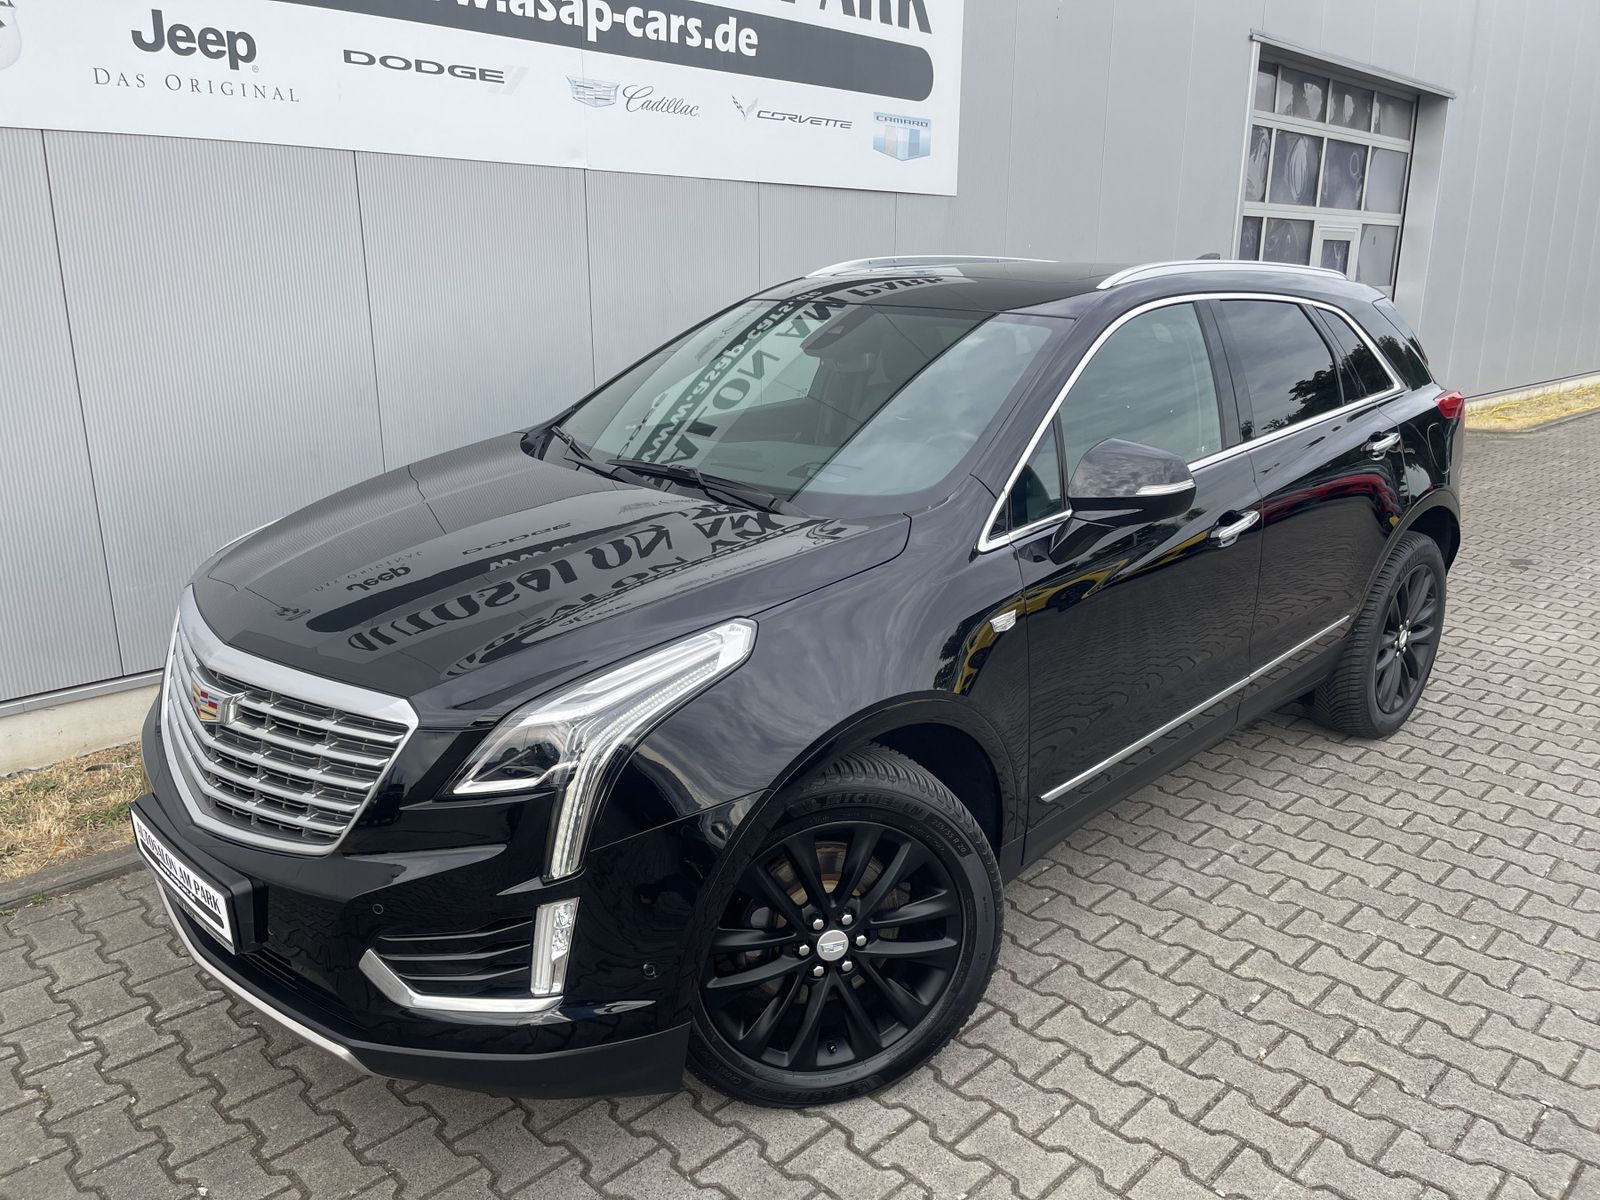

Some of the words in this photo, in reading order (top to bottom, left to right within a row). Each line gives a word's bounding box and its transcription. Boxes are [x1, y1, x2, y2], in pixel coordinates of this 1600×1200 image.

[131, 9, 257, 70] Jeep
[343, 49, 505, 84] DODGE
[93, 67, 146, 88] DAS
[165, 74, 299, 102] ORIGINAL
[622, 84, 699, 117] Cadillac
[757, 110, 853, 129] CORVETTE
[876, 115, 929, 128] CAMARO
[179, 866, 193, 890] AM
[193, 879, 222, 915] PARK
